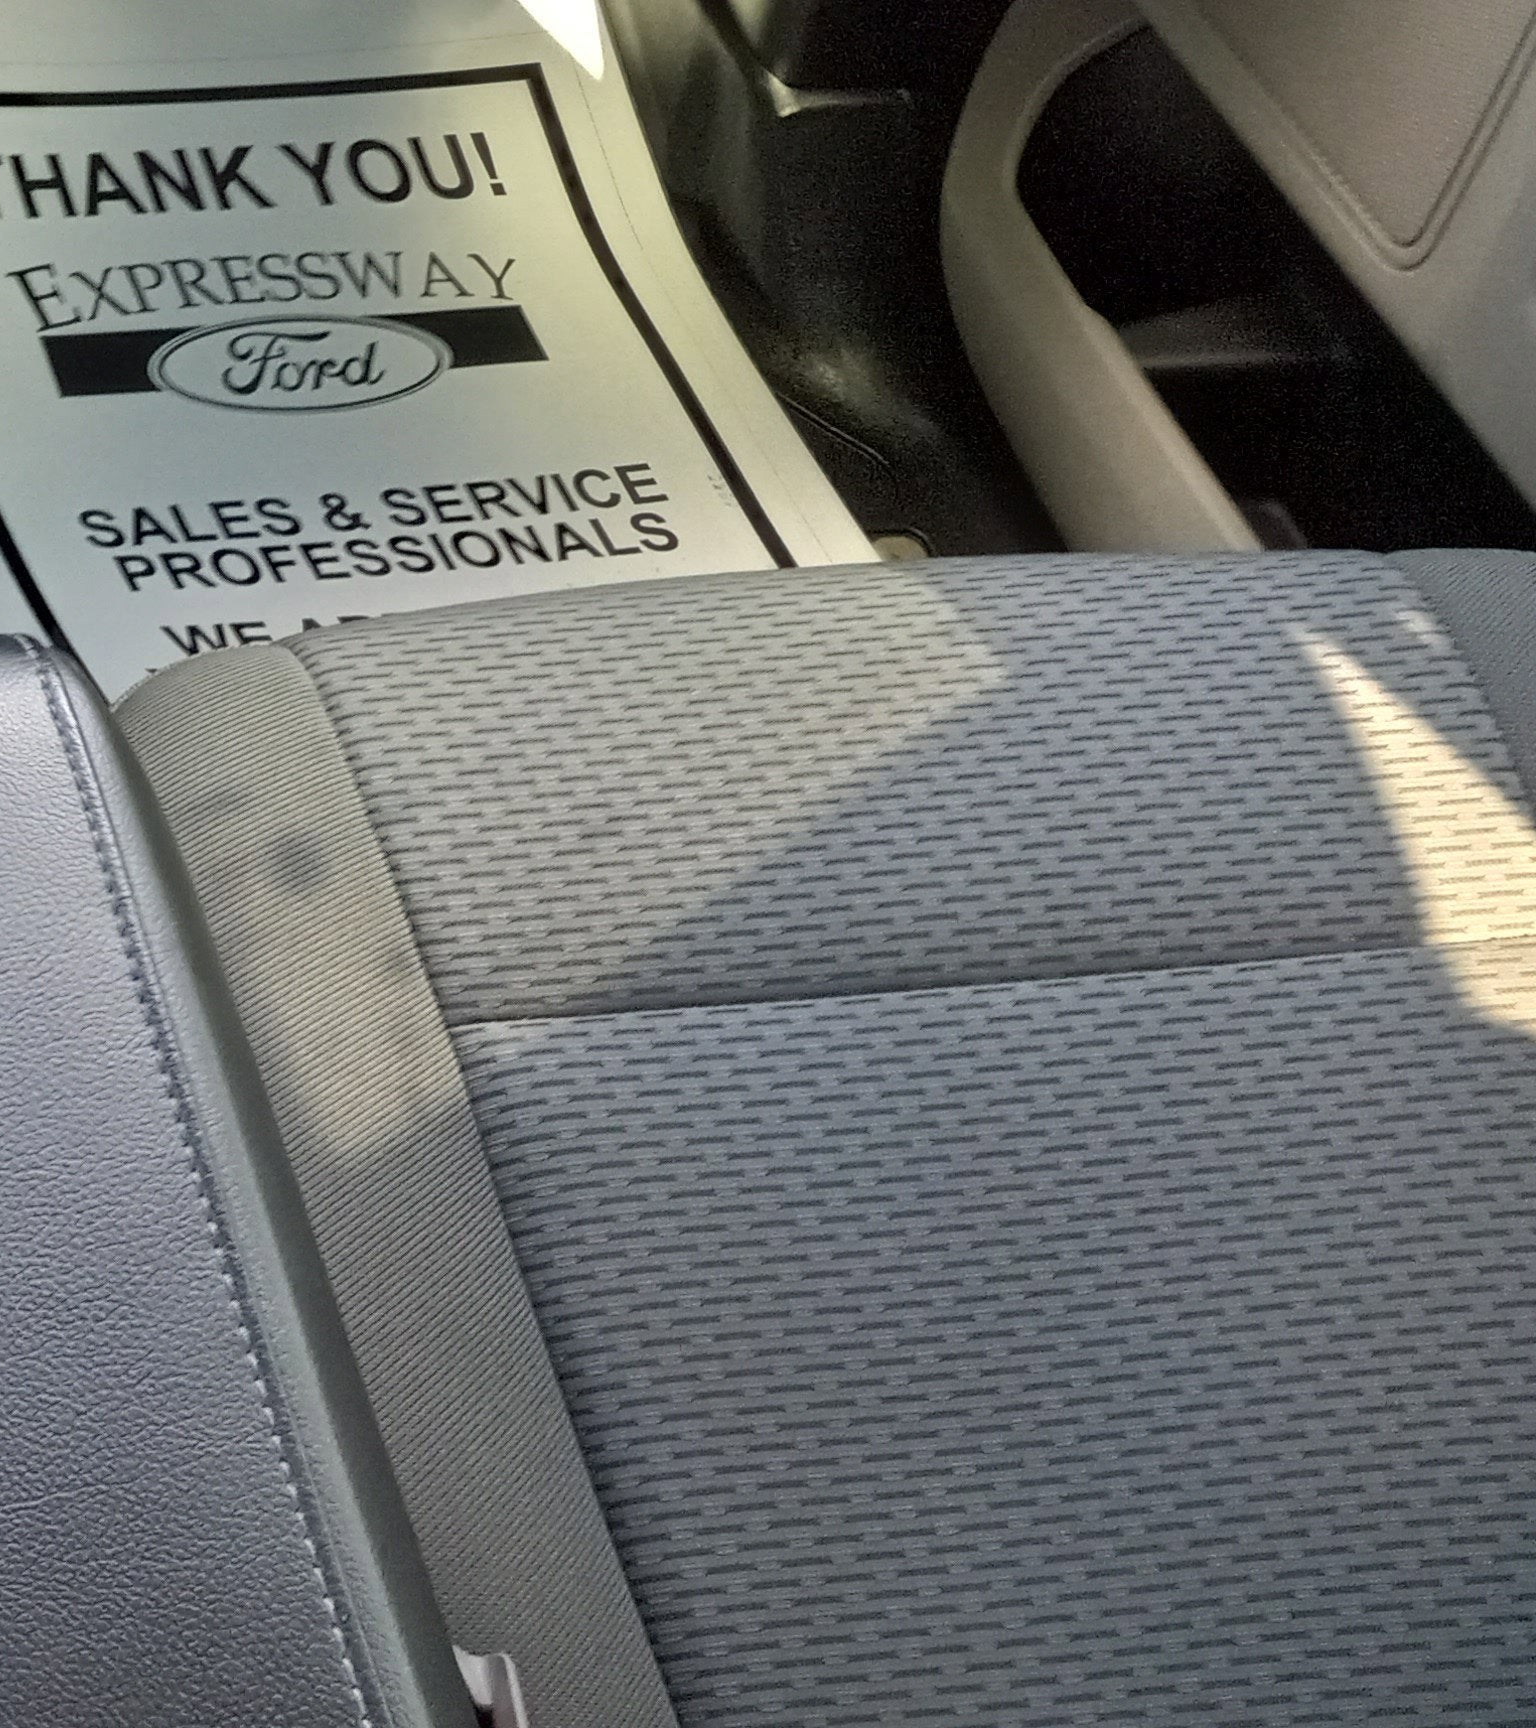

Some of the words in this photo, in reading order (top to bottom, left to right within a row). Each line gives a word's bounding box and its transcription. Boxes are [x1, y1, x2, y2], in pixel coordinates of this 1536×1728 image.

[280, 132, 508, 206] YOU!
[7, 251, 518, 332] EXPRESSWAY
[220, 332, 386, 395] Ford
[78, 497, 301, 548] SALES
[325, 491, 370, 532] &
[384, 463, 668, 527] SERVICE
[115, 511, 680, 593] PROFESSIONALS
